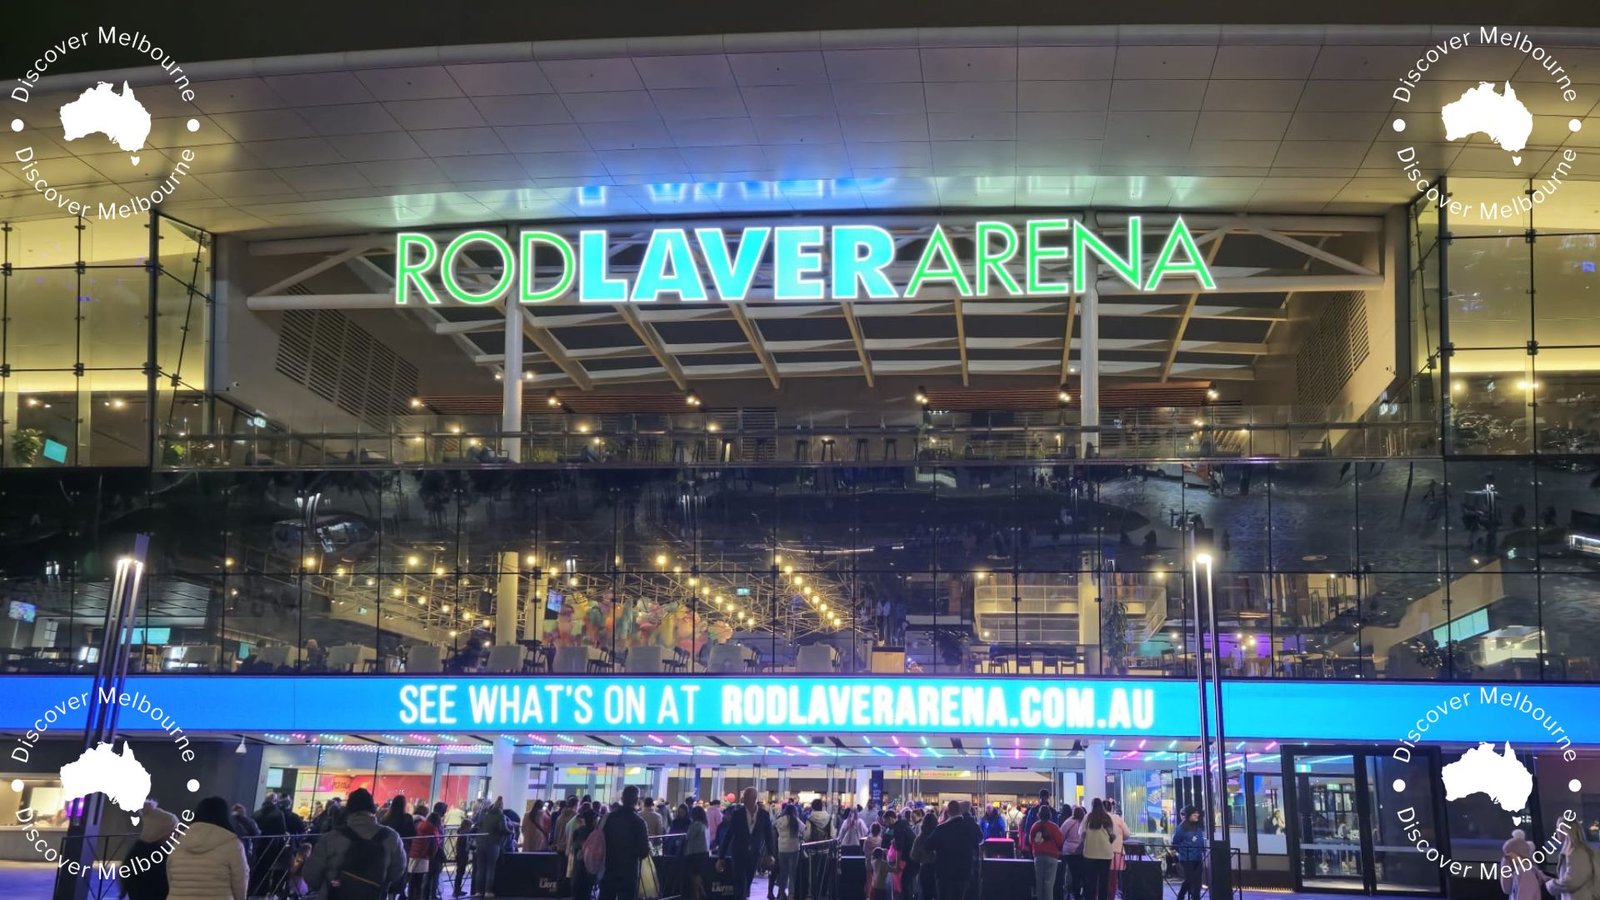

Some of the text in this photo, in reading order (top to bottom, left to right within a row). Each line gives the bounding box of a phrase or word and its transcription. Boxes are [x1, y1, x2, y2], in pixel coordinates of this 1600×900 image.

[395, 214, 1217, 305] ROD LAVER ARENA
[399, 684, 1155, 730] SEE WHAT'S ON AT RODLAVERARENA.COM.AU
